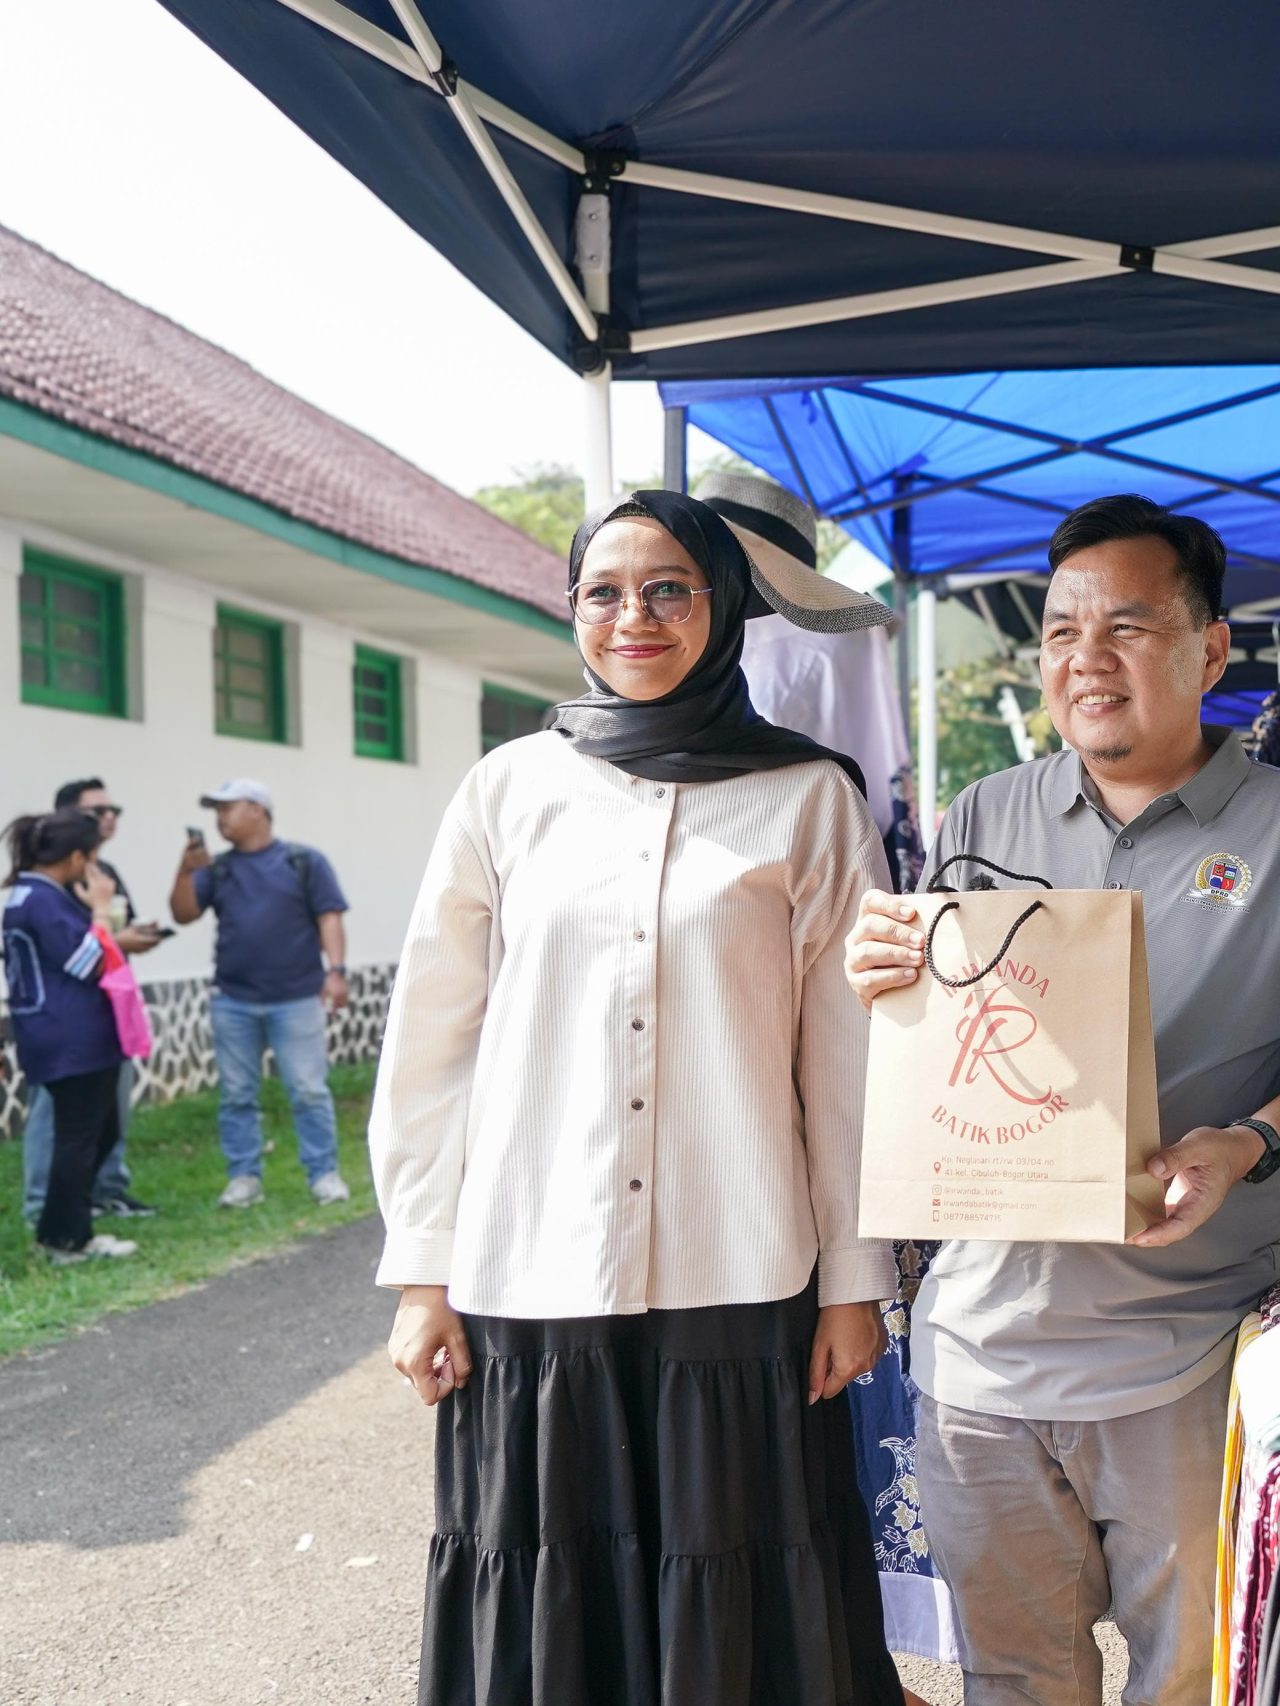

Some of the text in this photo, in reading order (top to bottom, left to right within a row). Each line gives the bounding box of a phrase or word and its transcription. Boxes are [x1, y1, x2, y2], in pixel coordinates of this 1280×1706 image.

[1210, 889, 1229, 898] DPRD
[931, 1094, 1070, 1145] BATIK BOGOR
[1027, 1169, 1049, 1179] Utara
